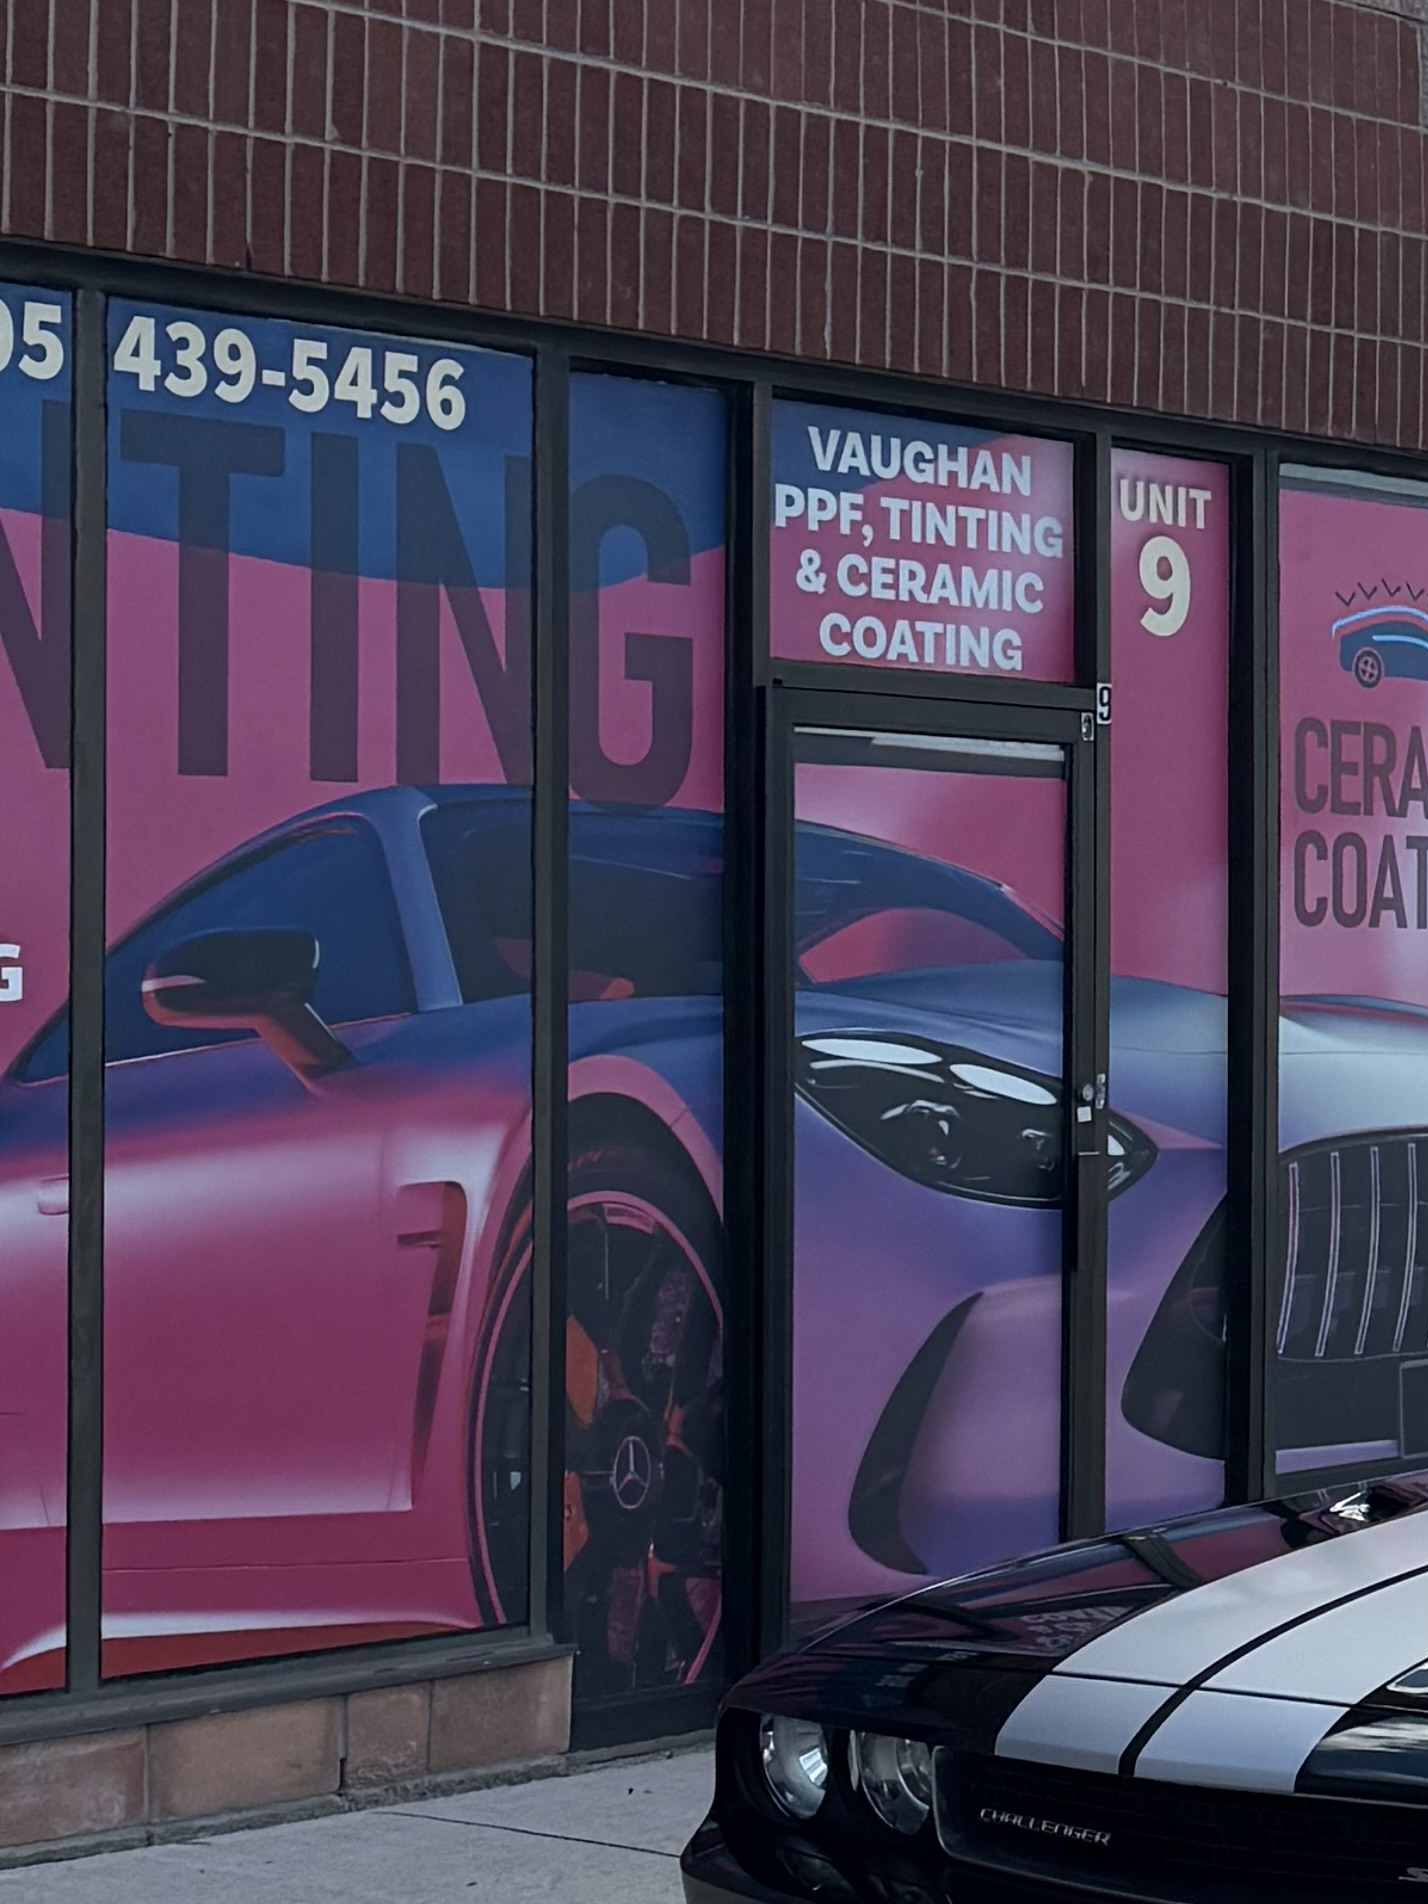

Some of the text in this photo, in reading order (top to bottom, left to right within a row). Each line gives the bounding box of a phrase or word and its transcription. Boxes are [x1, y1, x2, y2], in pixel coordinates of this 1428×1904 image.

[113, 315, 467, 431] 439-5456
[806, 425, 1031, 496] VAUGHAN
[775, 483, 1063, 559] PPF, TINTING
[1119, 477, 1212, 529] UNIT
[795, 548, 1044, 614] & CERAMIC
[1139, 535, 1191, 637] 9
[819, 612, 1023, 671] COATING
[1098, 686, 1112, 722] 9
[980, 1807, 1112, 1846] CHALLENGER
